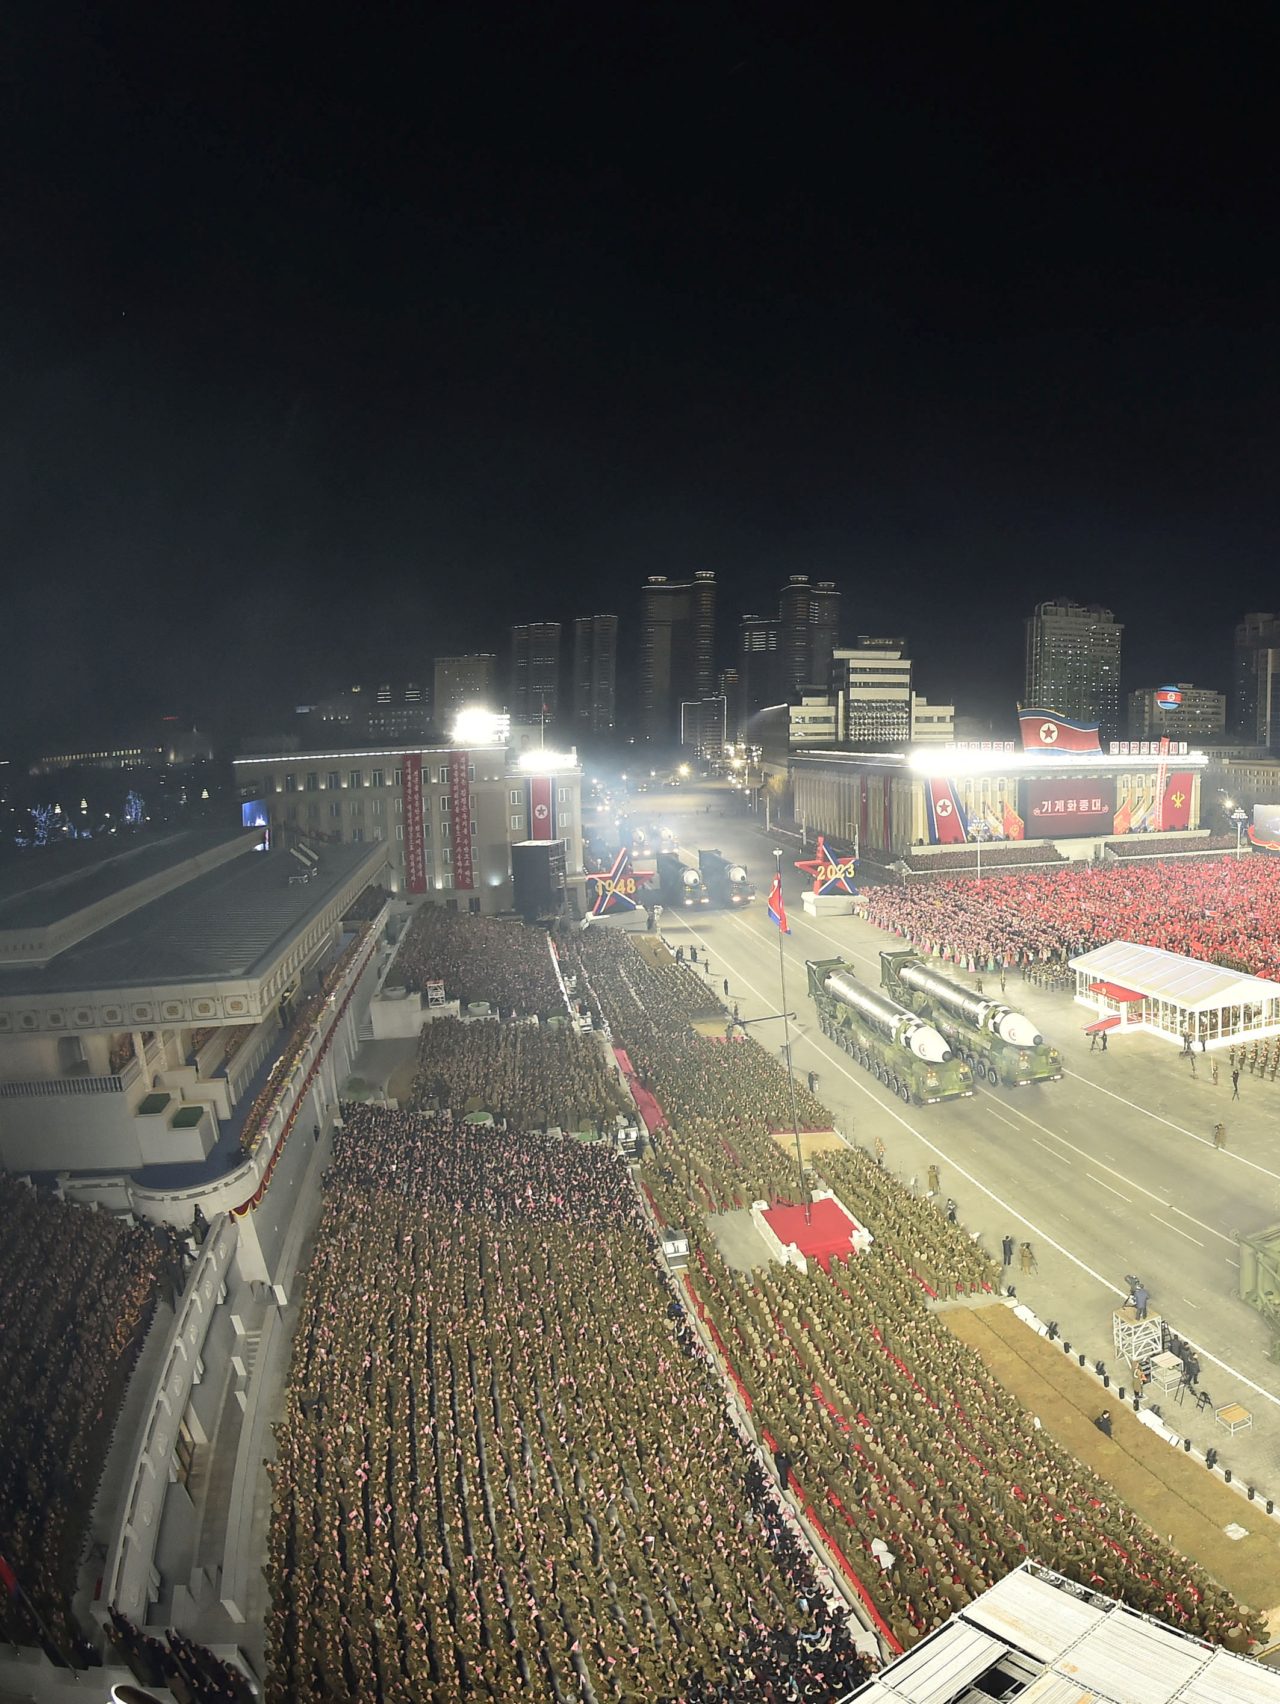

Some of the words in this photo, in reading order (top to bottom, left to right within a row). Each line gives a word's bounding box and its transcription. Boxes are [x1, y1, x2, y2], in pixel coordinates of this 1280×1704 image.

[1110, 742, 1185, 753] 인민공화국세!
[1041, 798, 1101, 813] 기계화종대
[817, 863, 855, 880] 2023
[595, 878, 636, 896] 1948
